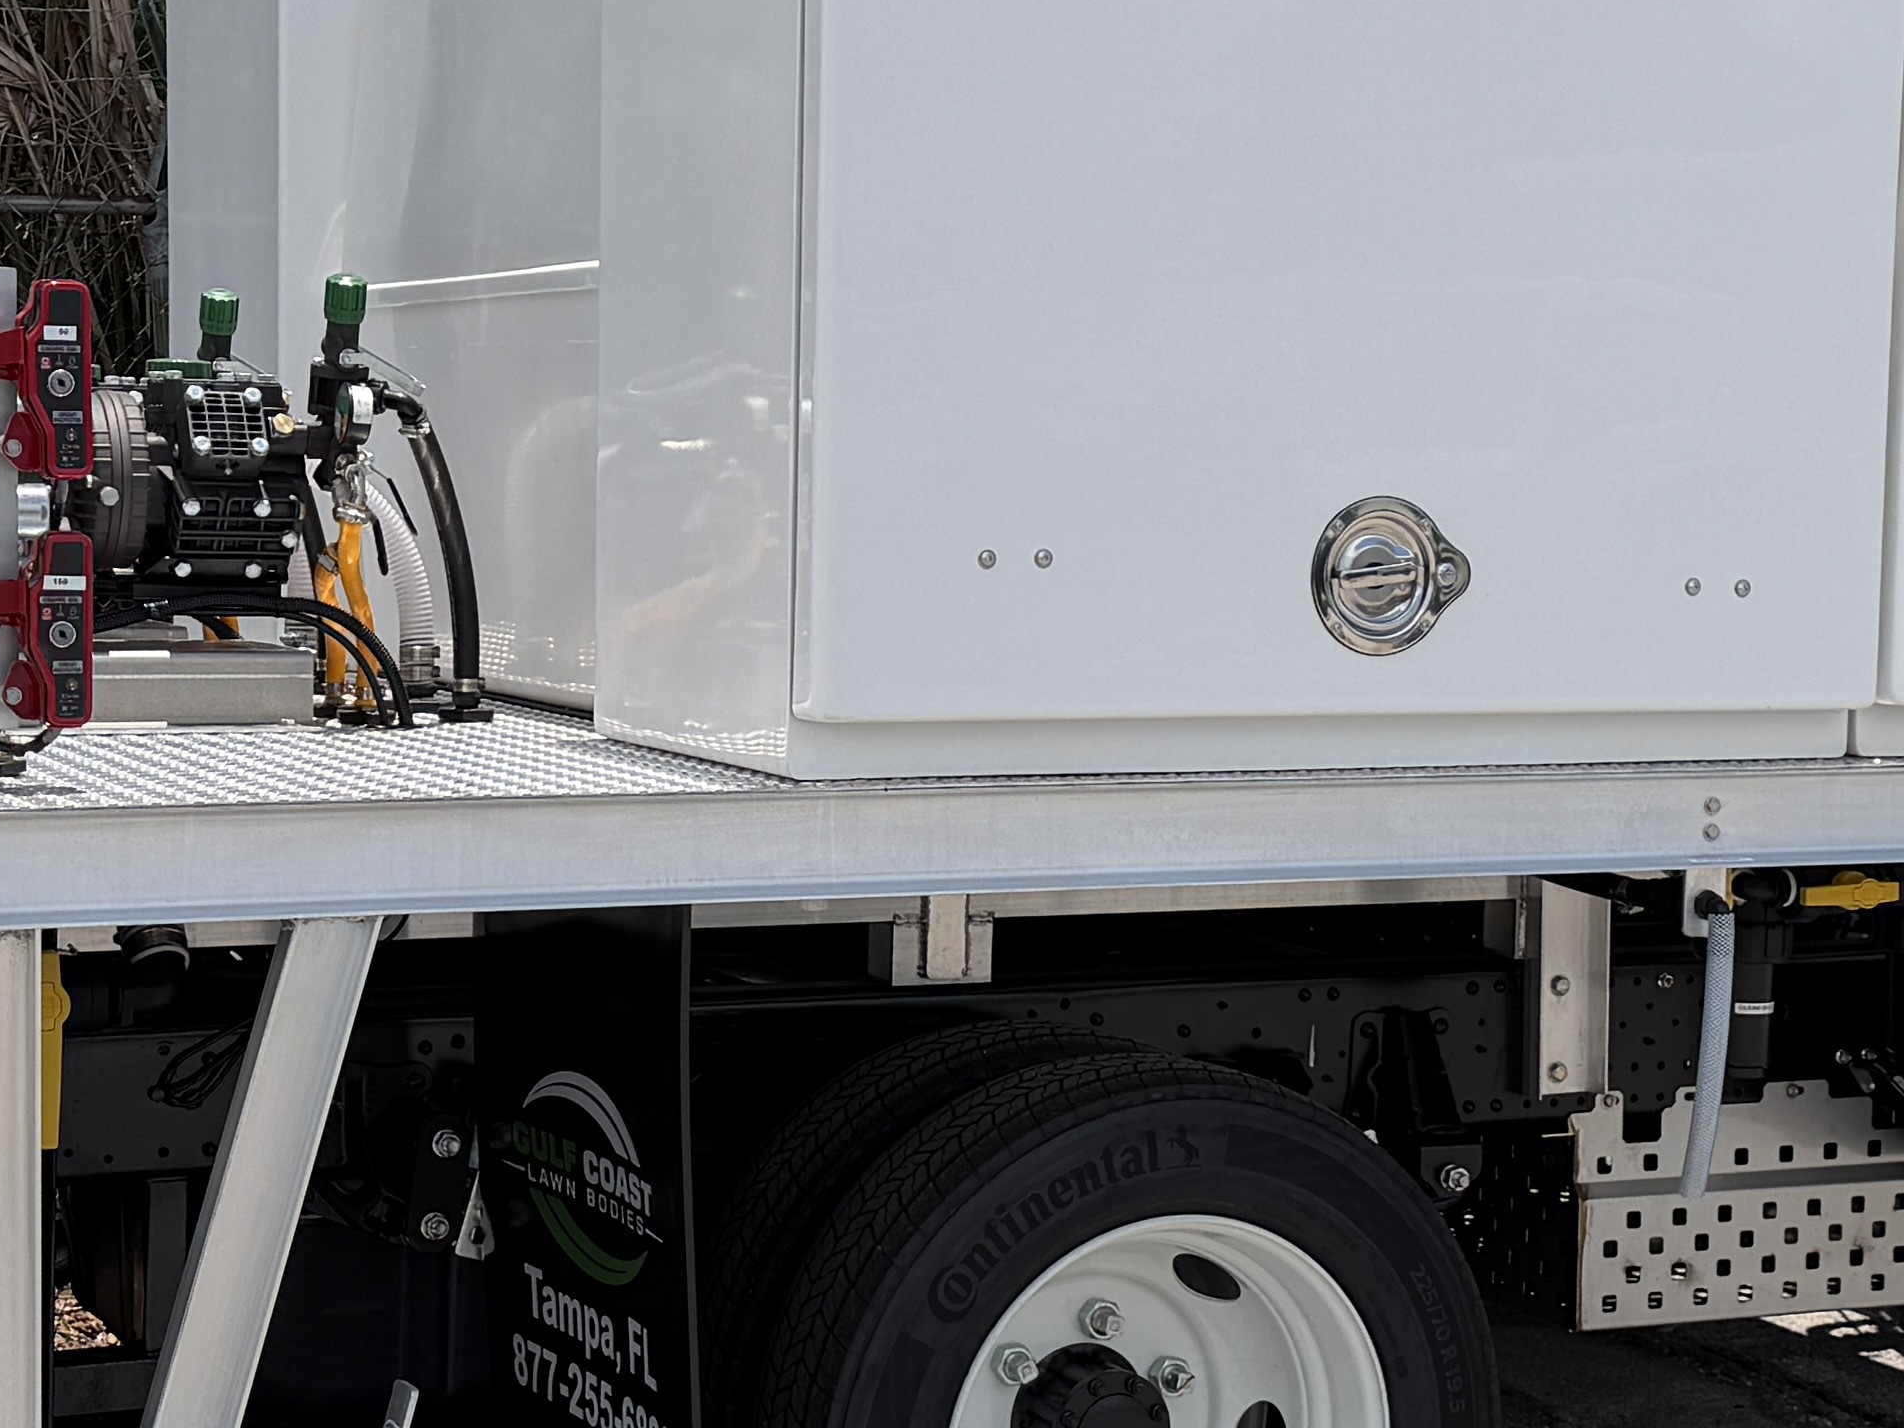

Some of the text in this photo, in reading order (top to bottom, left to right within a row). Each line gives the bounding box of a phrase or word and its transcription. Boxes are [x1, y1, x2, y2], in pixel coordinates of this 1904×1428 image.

[512, 1121, 653, 1217] GULF COAST
[527, 1162, 645, 1237] LAWN BODIES
[927, 1129, 1162, 1323] Continental
[524, 1262, 659, 1393] Tampa, FL
[1408, 1263, 1452, 1342] 225/70
